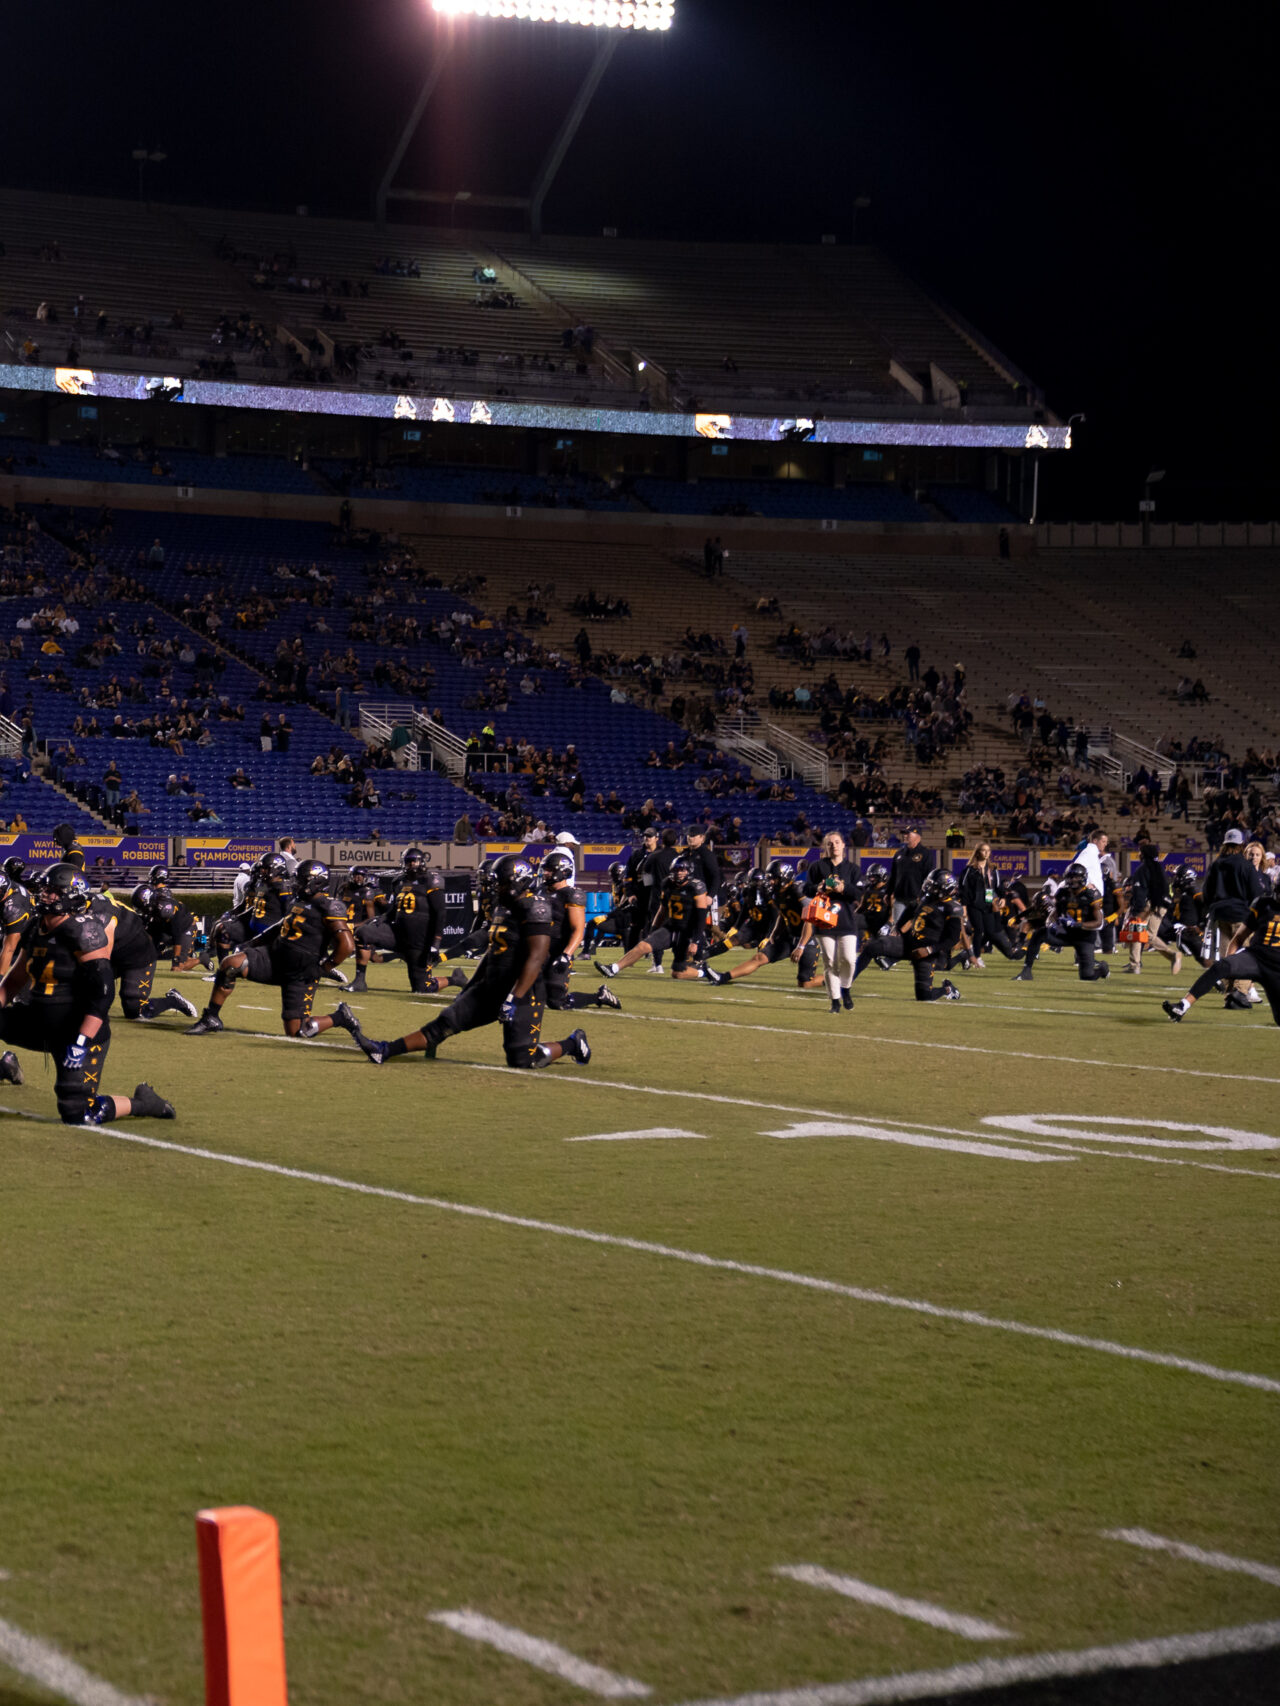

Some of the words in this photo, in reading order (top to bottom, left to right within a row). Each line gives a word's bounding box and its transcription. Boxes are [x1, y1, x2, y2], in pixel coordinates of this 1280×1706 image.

[137, 842, 166, 851] TOOTIE
[227, 844, 273, 852] CONFERENCE
[28, 849, 63, 859] INMAN
[122, 850, 166, 861] ROBBINS
[339, 850, 394, 862] BAGWELL
